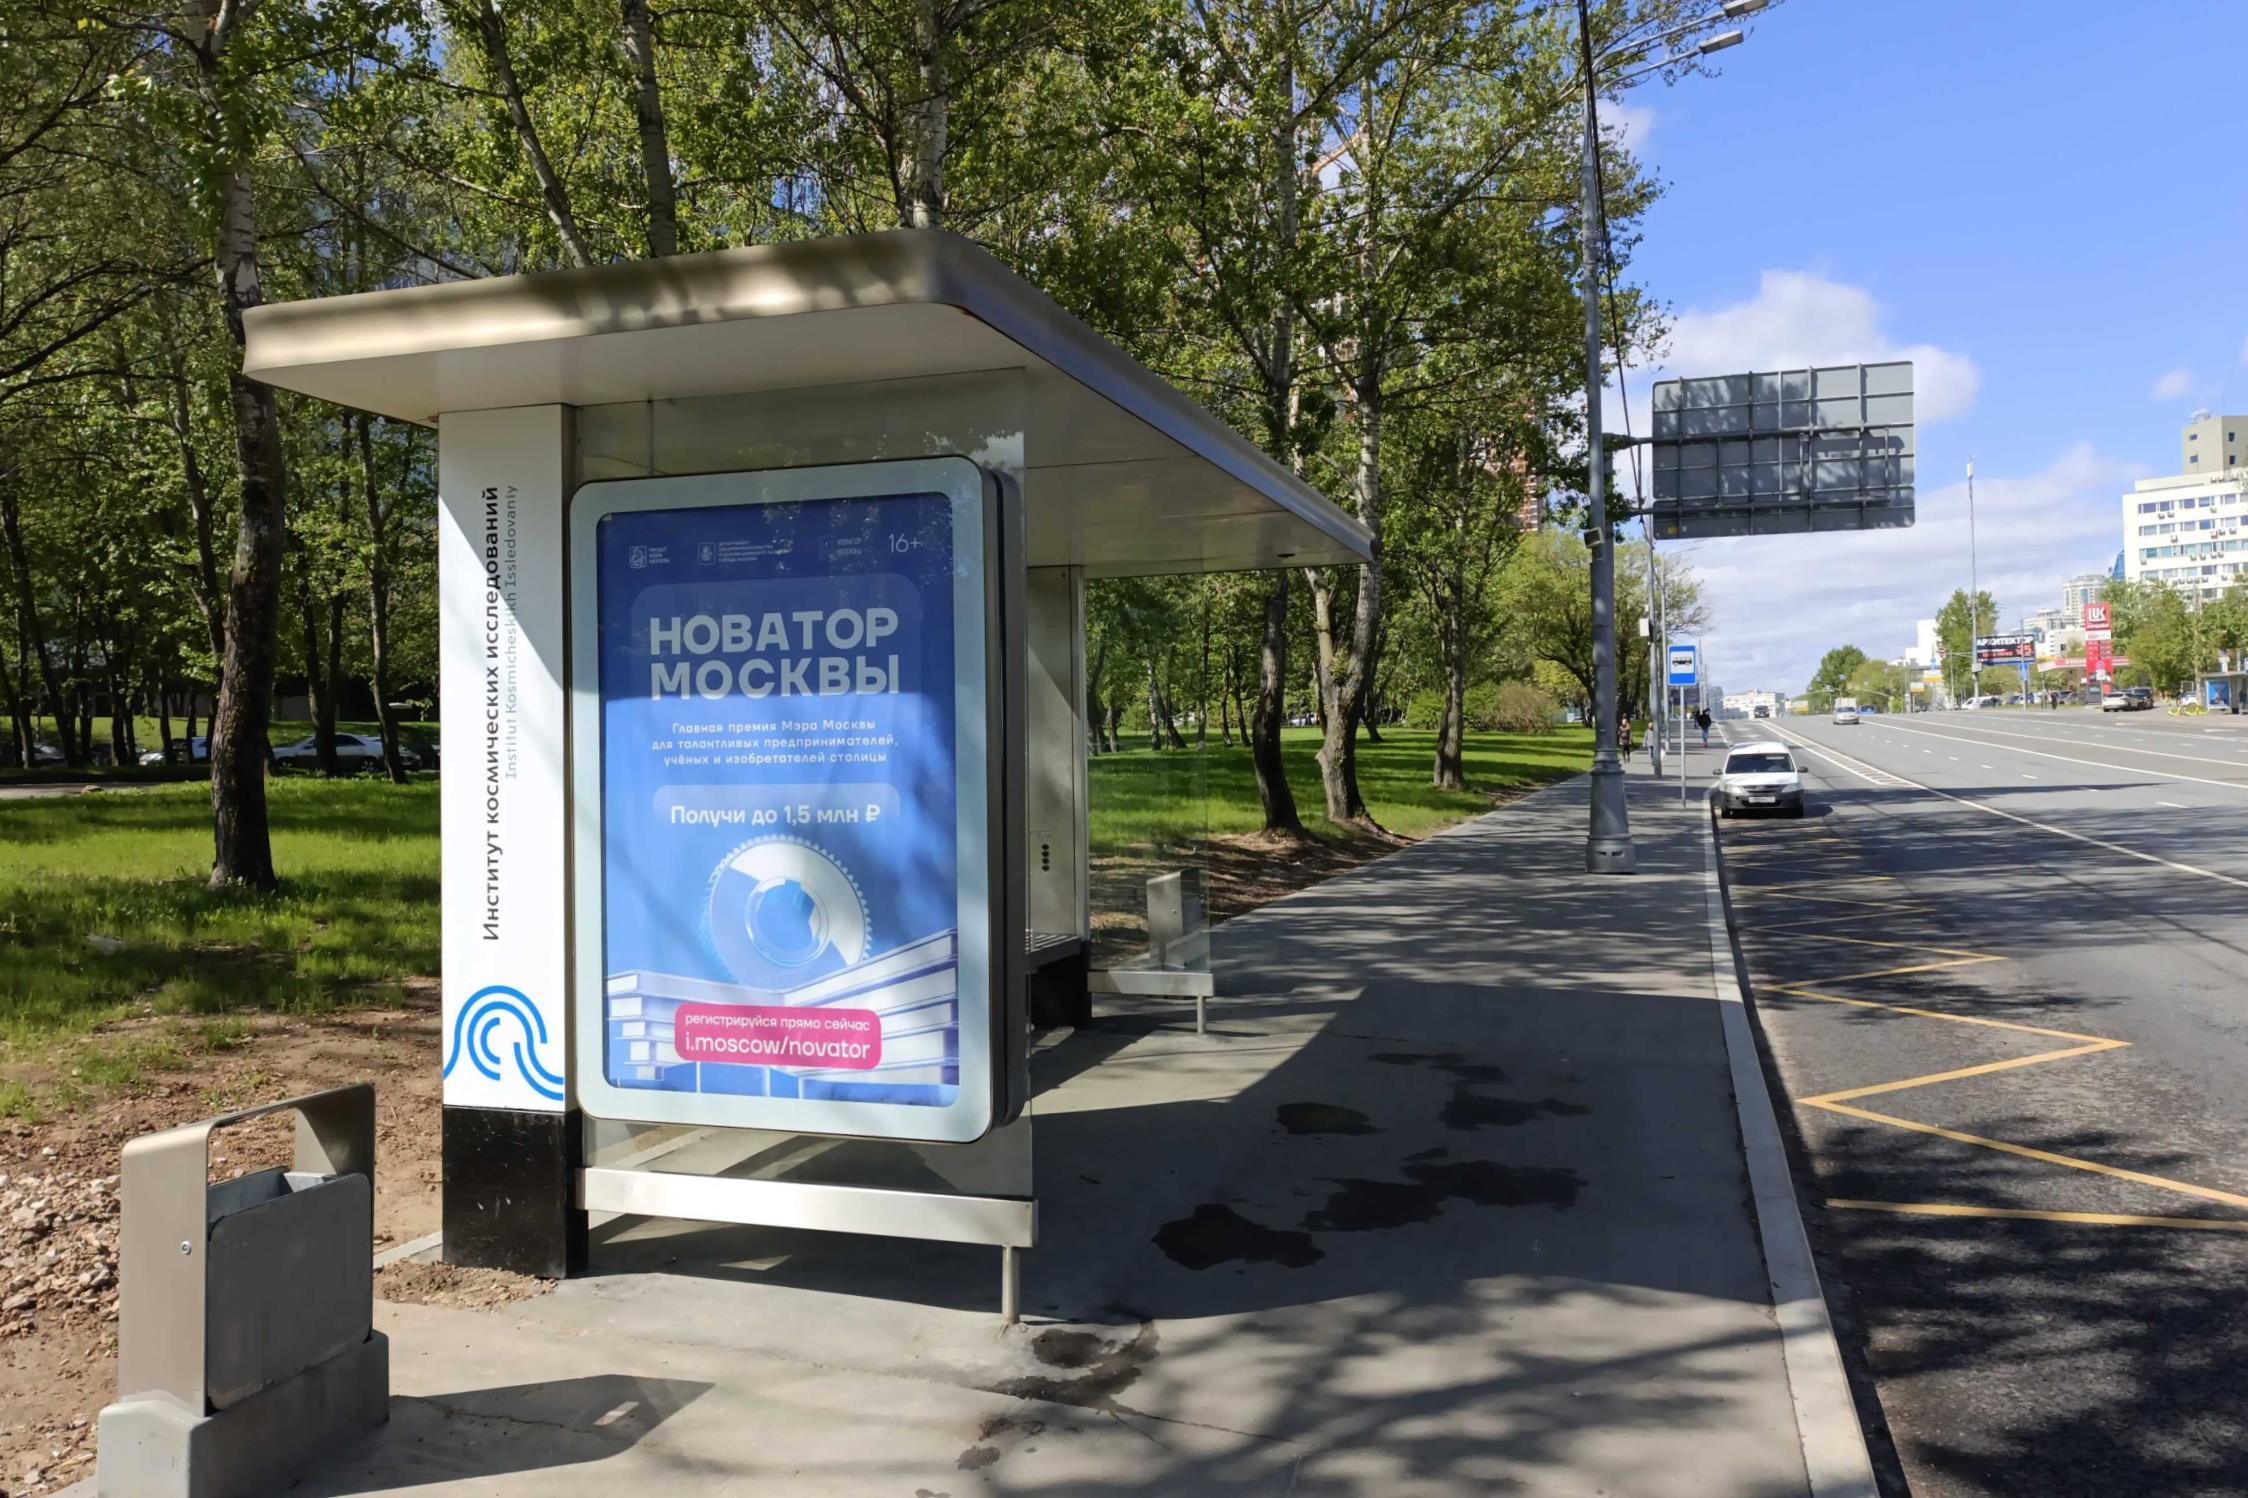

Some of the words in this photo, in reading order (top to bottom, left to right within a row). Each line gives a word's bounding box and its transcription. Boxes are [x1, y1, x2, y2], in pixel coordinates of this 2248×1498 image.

[504, 485, 519, 588] Issledovaniy
[888, 532, 921, 553] 16+
[482, 486, 502, 659] исследований
[504, 592, 518, 714] Kosmicheskikh
[650, 607, 899, 655] НОВАТОР
[651, 654, 899, 700] МОСКВЫ
[486, 665, 500, 825] космических
[504, 718, 518, 779] Institut
[652, 740, 673, 751] для
[678, 737, 759, 749] талантливых
[672, 722, 723, 734] Главная
[728, 722, 776, 735] премия
[782, 720, 818, 734] Мэра
[822, 719, 876, 732] Москвы
[664, 752, 709, 767] учёных
[713, 754, 721, 764] и
[726, 750, 825, 765] изобретателей
[830, 751, 887, 763] столицы
[670, 805, 746, 828] Получи
[752, 809, 778, 825] до
[783, 804, 811, 826] 1,5
[817, 809, 859, 824] млн
[483, 831, 503, 941] Институт
[685, 1013, 778, 1028] регистрируйся
[781, 1017, 822, 1031] прямо
[824, 1017, 870, 1032] сейчас
[685, 1031, 870, 1059] i.moscow/novator
